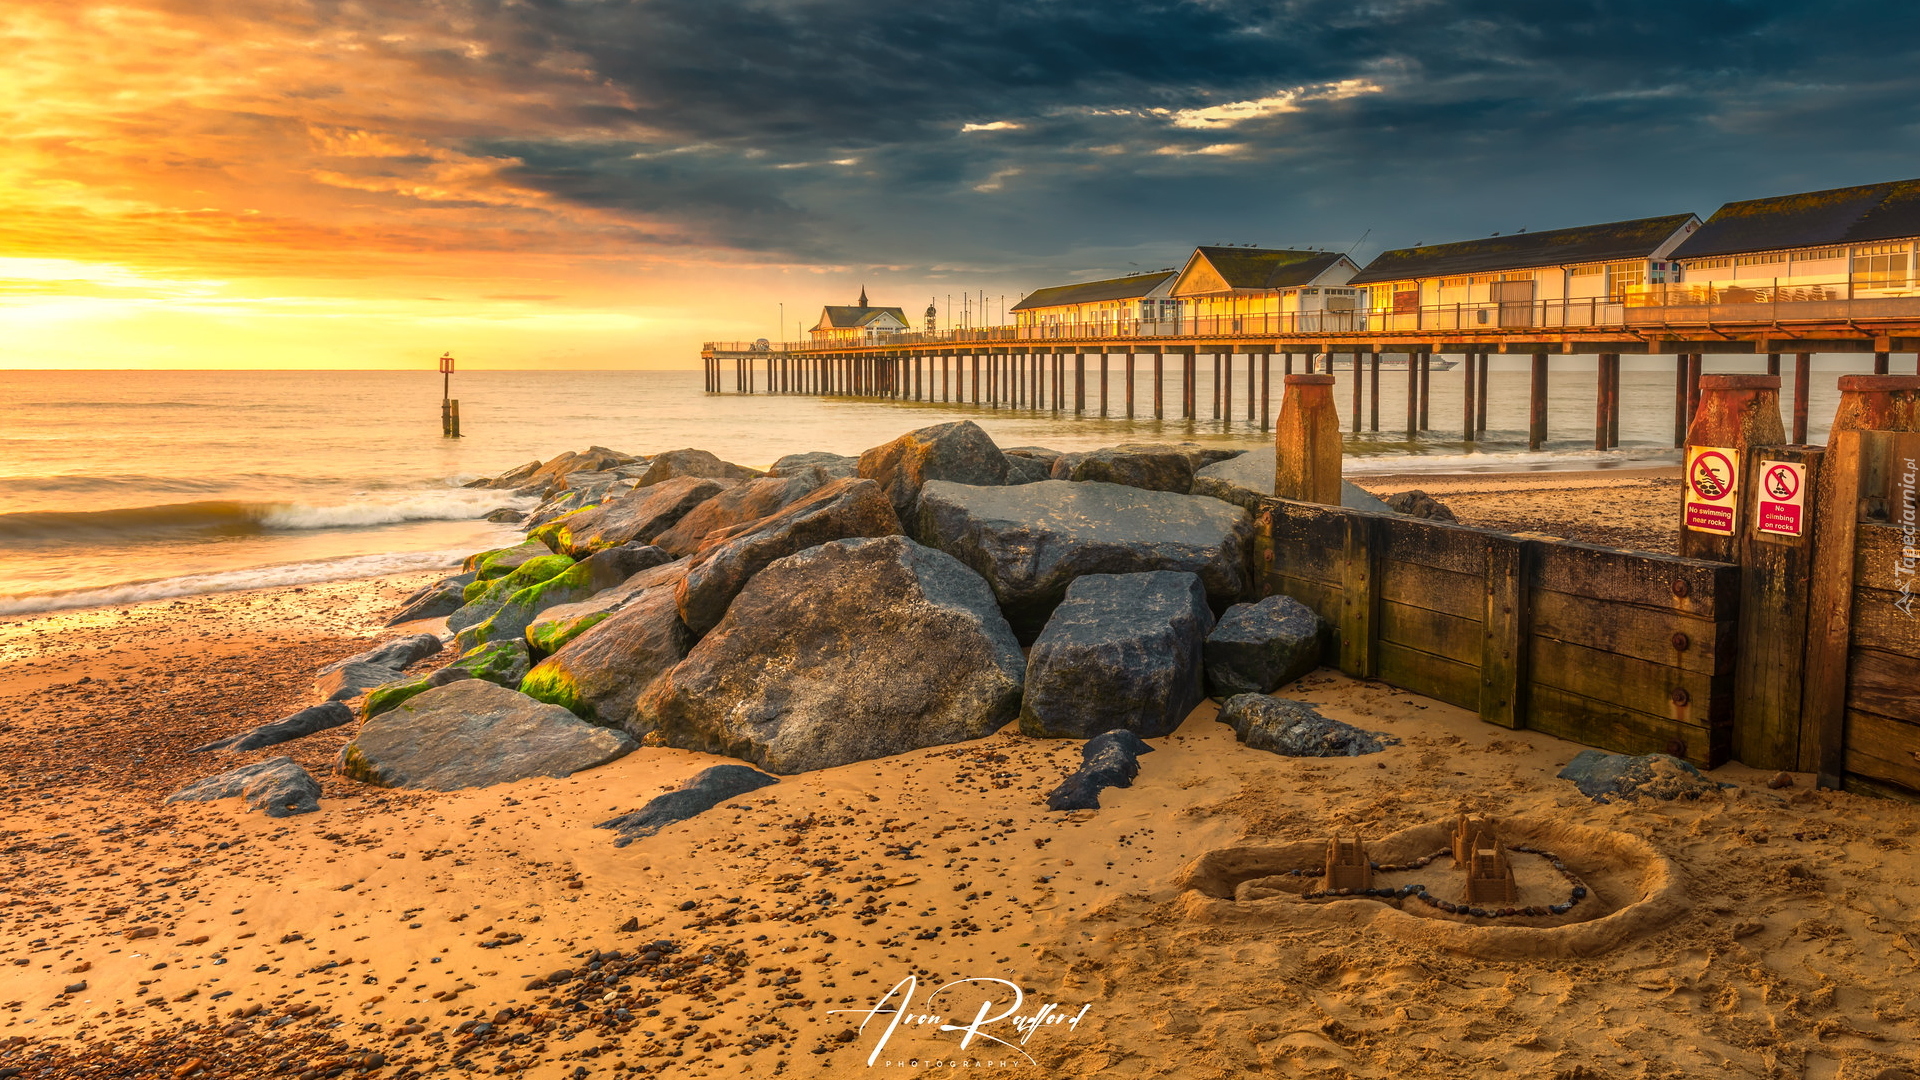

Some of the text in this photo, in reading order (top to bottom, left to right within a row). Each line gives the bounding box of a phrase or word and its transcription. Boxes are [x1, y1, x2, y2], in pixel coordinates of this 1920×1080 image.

[1688, 506, 1732, 519] No swimming
[1707, 517, 1726, 527] rocks
[1765, 513, 1794, 524] climbing
[1774, 523, 1794, 531] rocks
